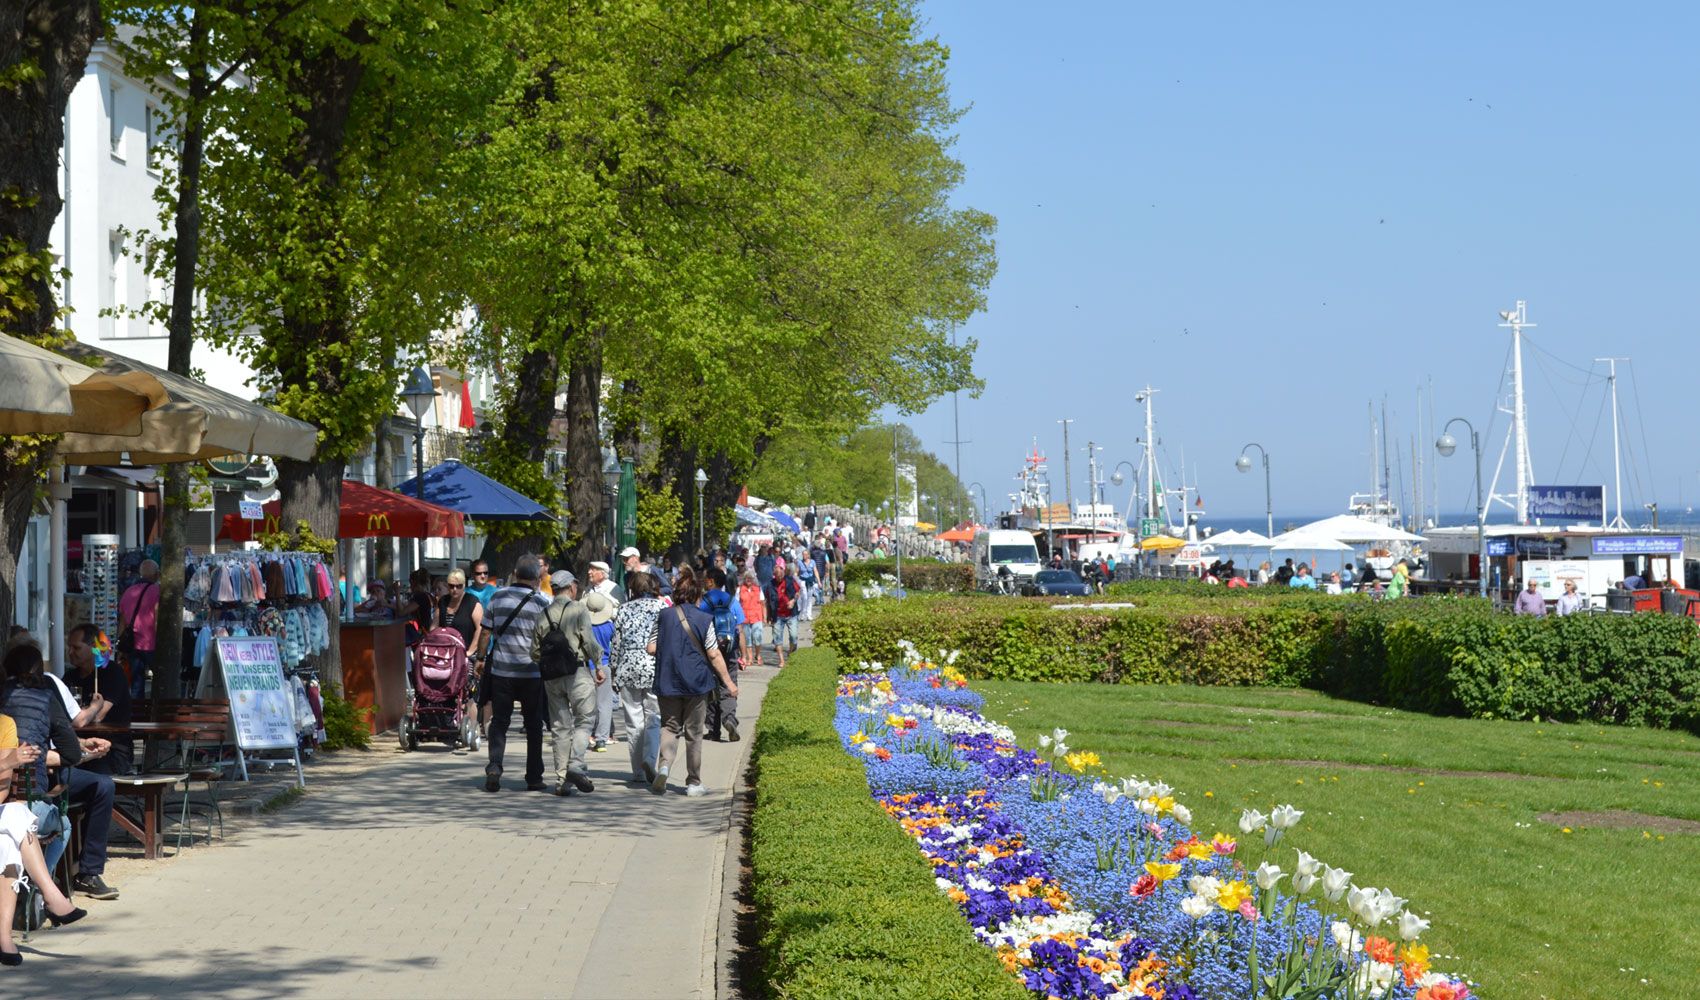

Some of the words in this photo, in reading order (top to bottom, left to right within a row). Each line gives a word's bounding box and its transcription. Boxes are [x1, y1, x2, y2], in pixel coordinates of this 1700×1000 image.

[223, 643, 239, 661] DEIN
[252, 643, 276, 661] STYLE
[226, 664, 240, 673] MIT
[242, 664, 277, 674] UNSEREN
[229, 675, 253, 690] NEUEN
[252, 675, 281, 691] BRANDS
